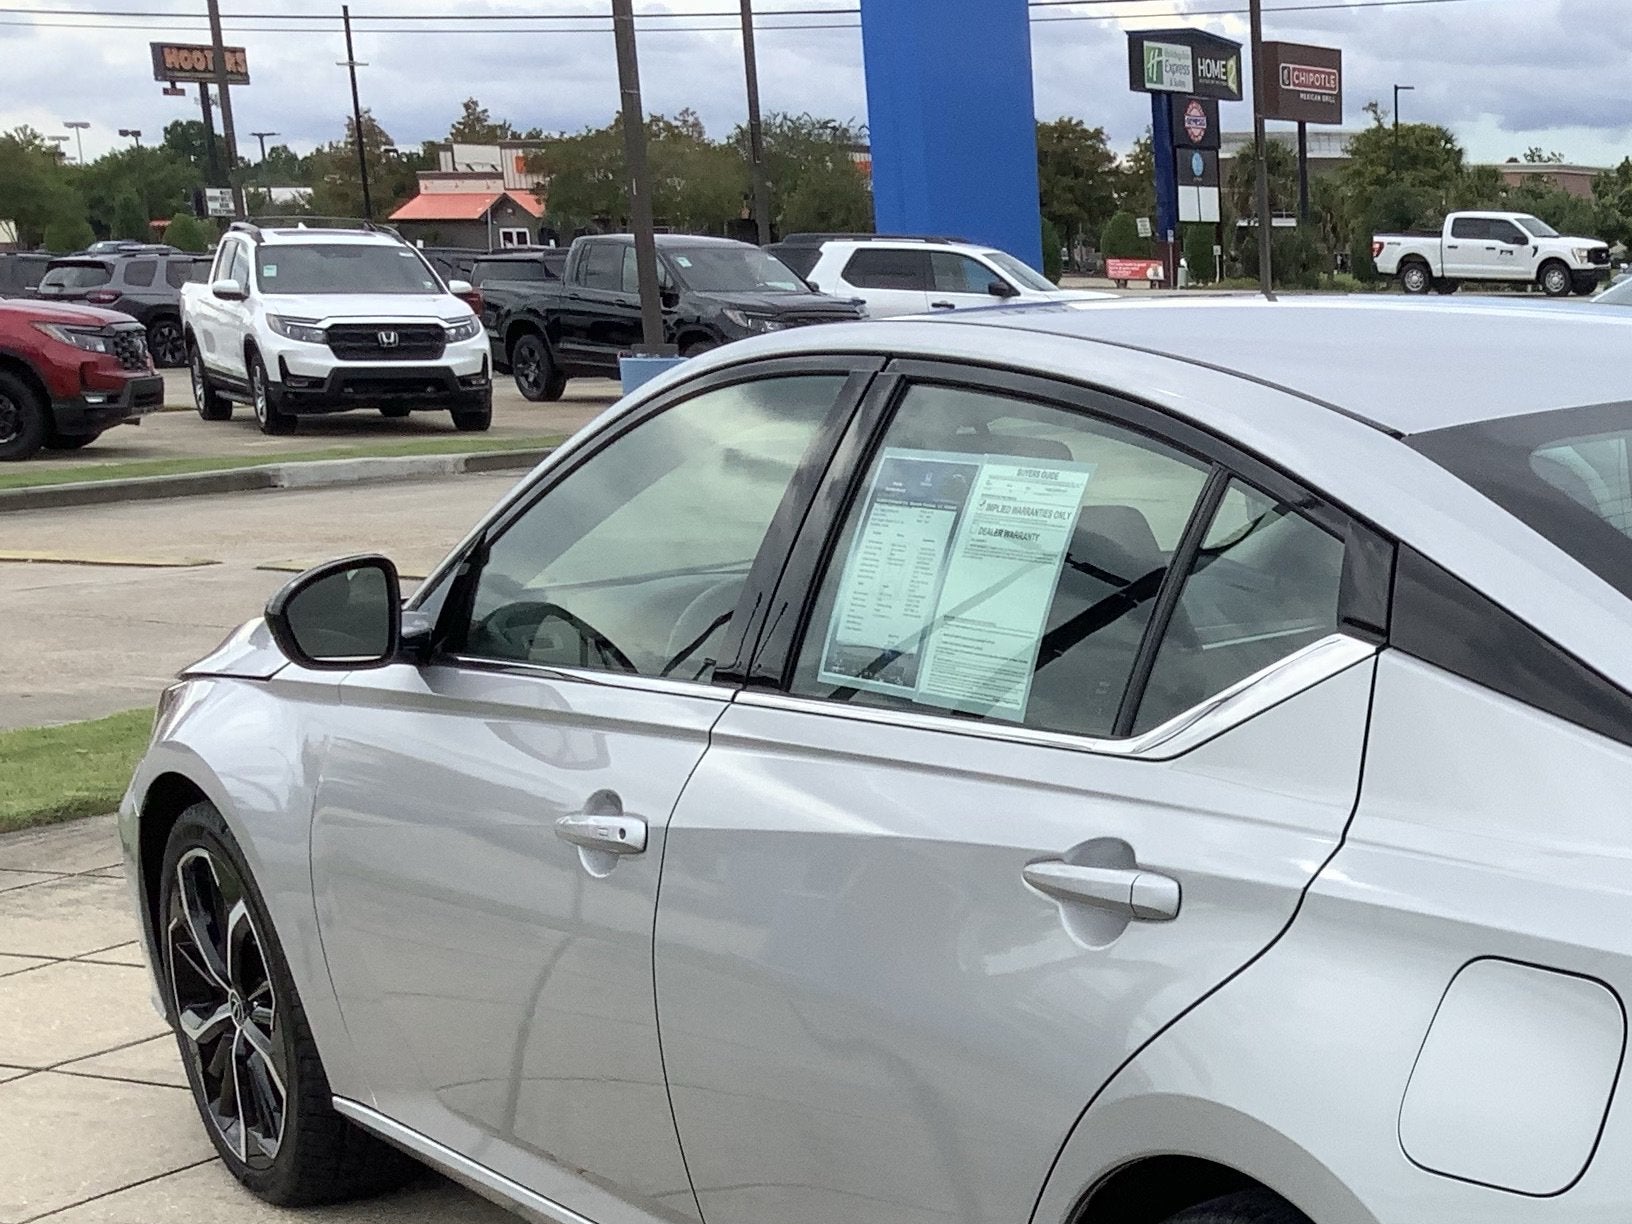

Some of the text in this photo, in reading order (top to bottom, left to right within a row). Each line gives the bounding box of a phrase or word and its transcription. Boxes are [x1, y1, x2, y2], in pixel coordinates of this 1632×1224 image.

[163, 47, 246, 73] HOOTRS
[1198, 57, 1226, 80] HOME
[1293, 70, 1336, 88] CHIPOTLE
[985, 502, 1012, 513] IMPLIED
[978, 526, 1004, 538] DEALER
